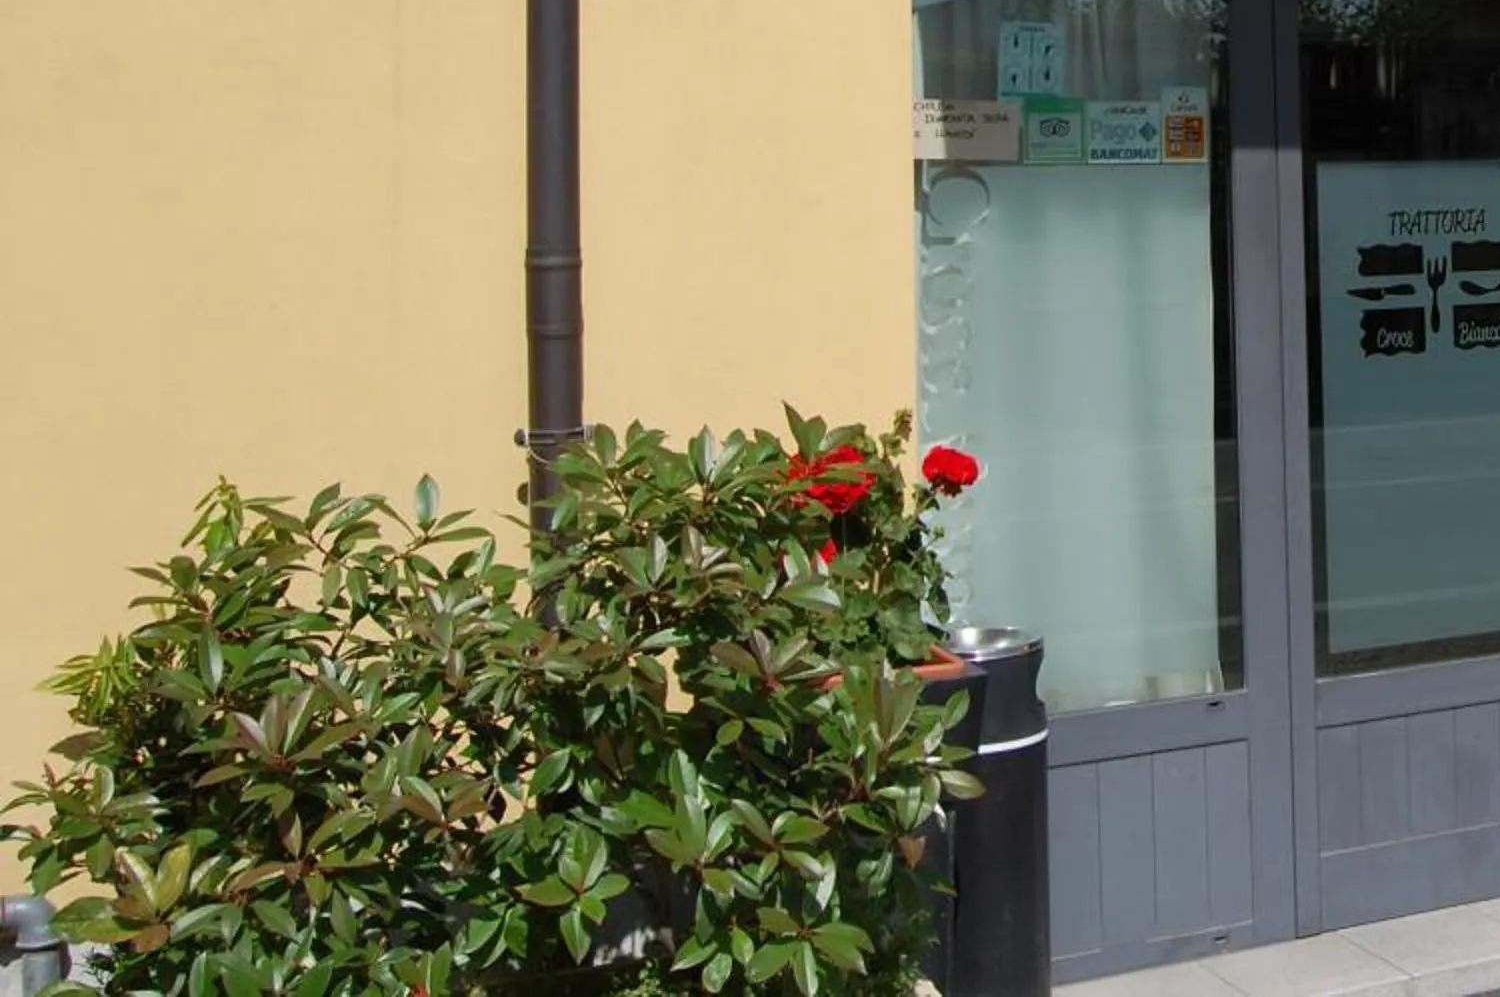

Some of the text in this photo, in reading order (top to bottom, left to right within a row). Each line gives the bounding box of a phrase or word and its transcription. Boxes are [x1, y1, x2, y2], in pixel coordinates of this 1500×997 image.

[1091, 121, 1136, 145] Pago
[1090, 148, 1157, 160] BANCOMAT
[1387, 208, 1486, 236] TRATTORIA
[1376, 328, 1415, 349] Croce
